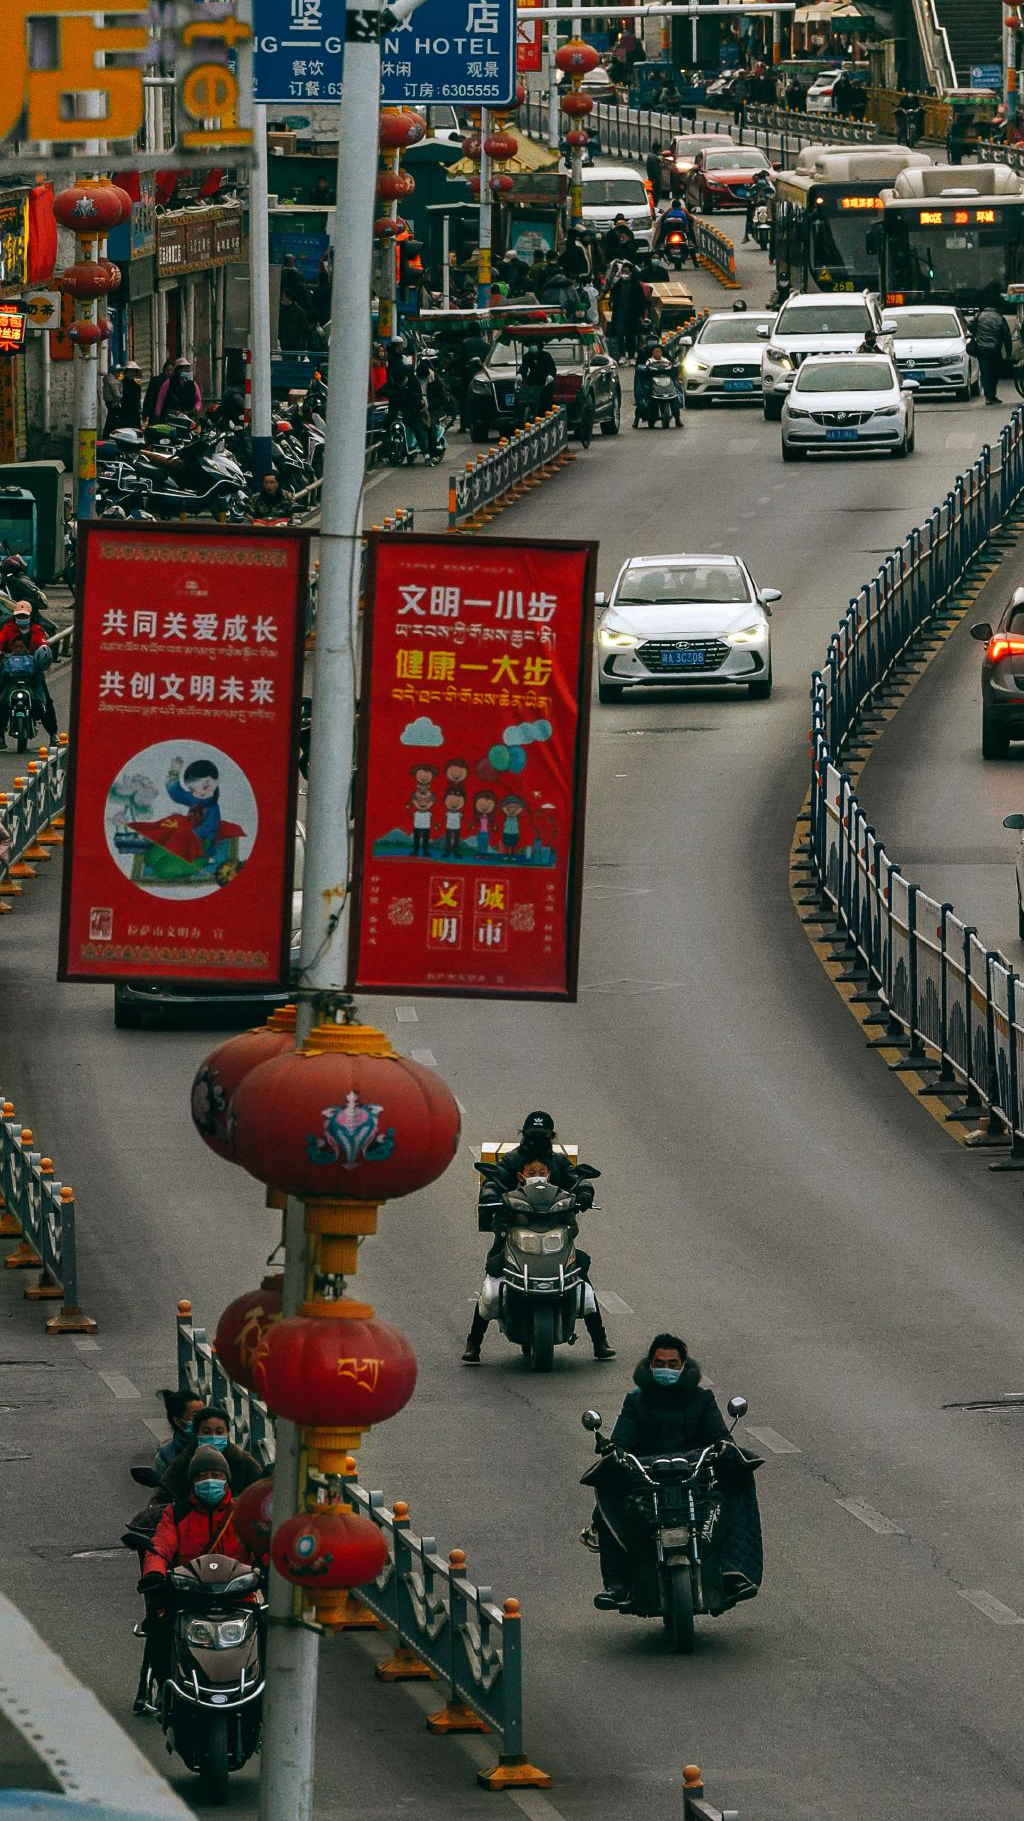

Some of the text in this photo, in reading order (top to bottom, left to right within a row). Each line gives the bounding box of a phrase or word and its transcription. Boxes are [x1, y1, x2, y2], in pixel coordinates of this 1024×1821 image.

[415, 37, 500, 55] HOTEL
[292, 60, 324, 76] 餐饮
[466, 61, 500, 78] 观景
[397, 584, 558, 623] 文明一小步
[101, 608, 278, 643] 共同关爱成长
[395, 648, 553, 687] 健康一大步
[99, 670, 275, 706] 共创文明未来
